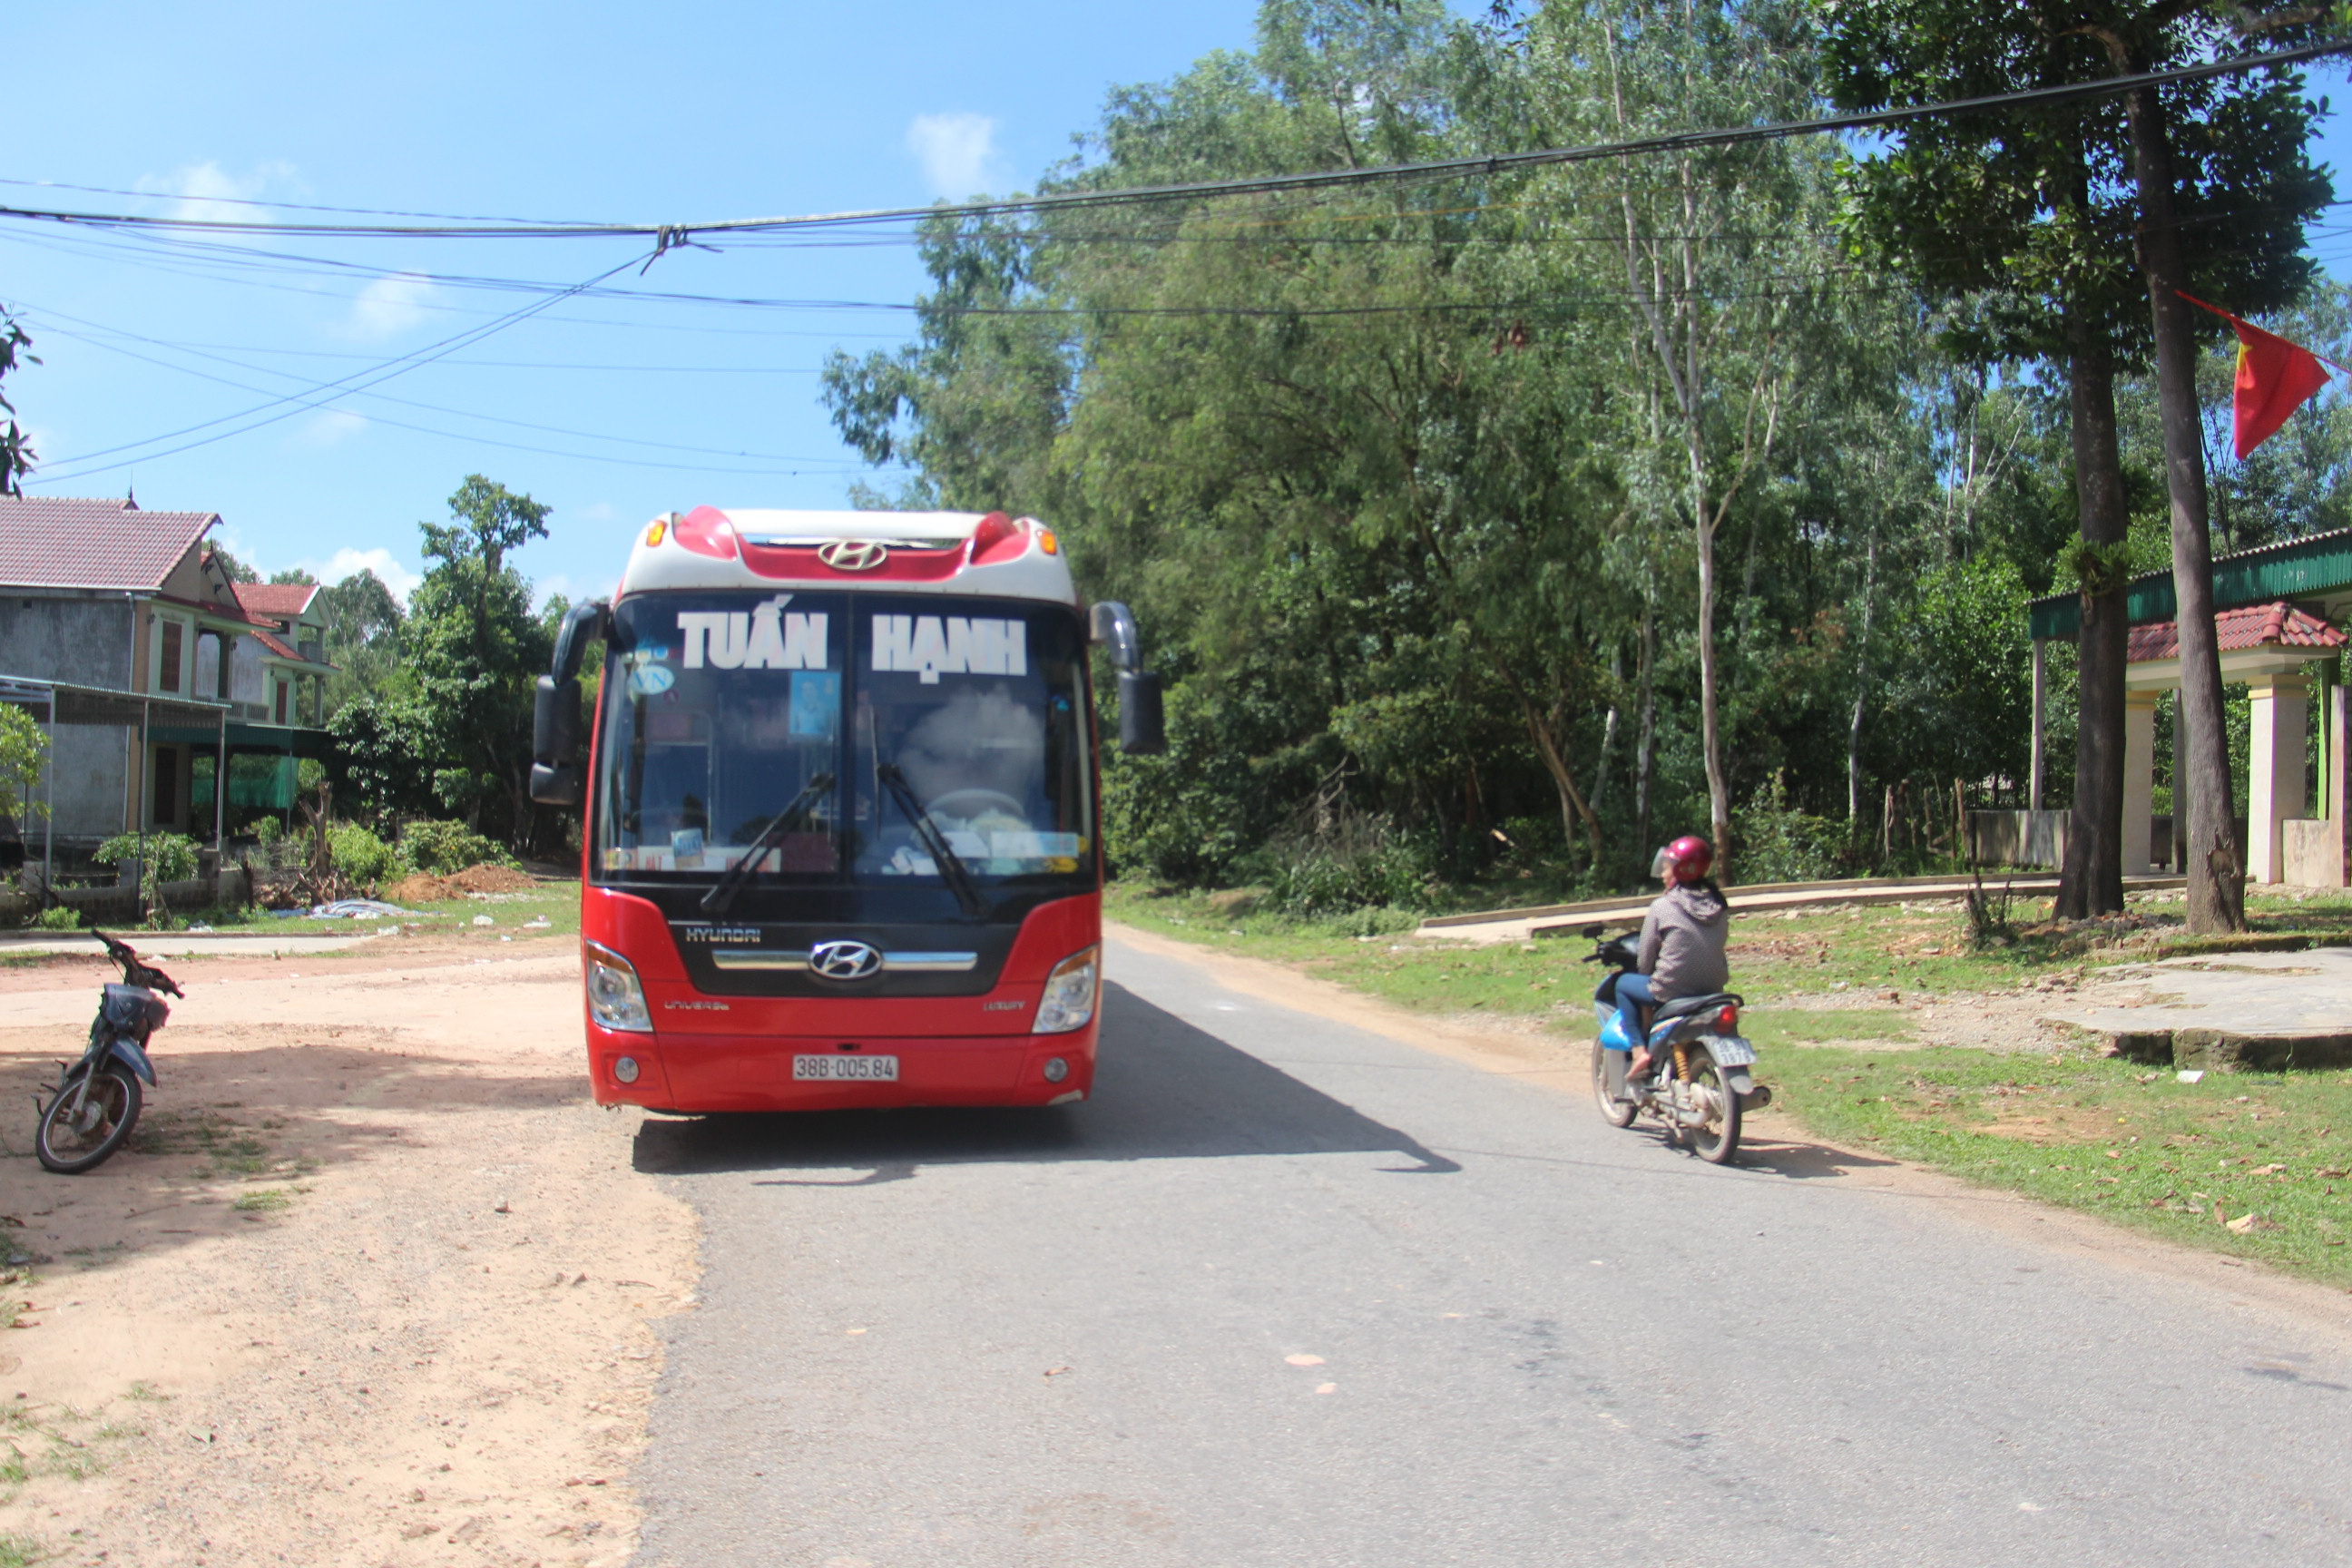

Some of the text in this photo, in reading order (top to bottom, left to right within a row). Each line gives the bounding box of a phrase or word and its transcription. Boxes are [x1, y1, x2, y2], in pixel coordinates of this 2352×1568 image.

[678, 593, 1027, 684] TUẤN HẠNH
[633, 671, 669, 690] VN
[686, 927, 761, 943] HYUNDAI
